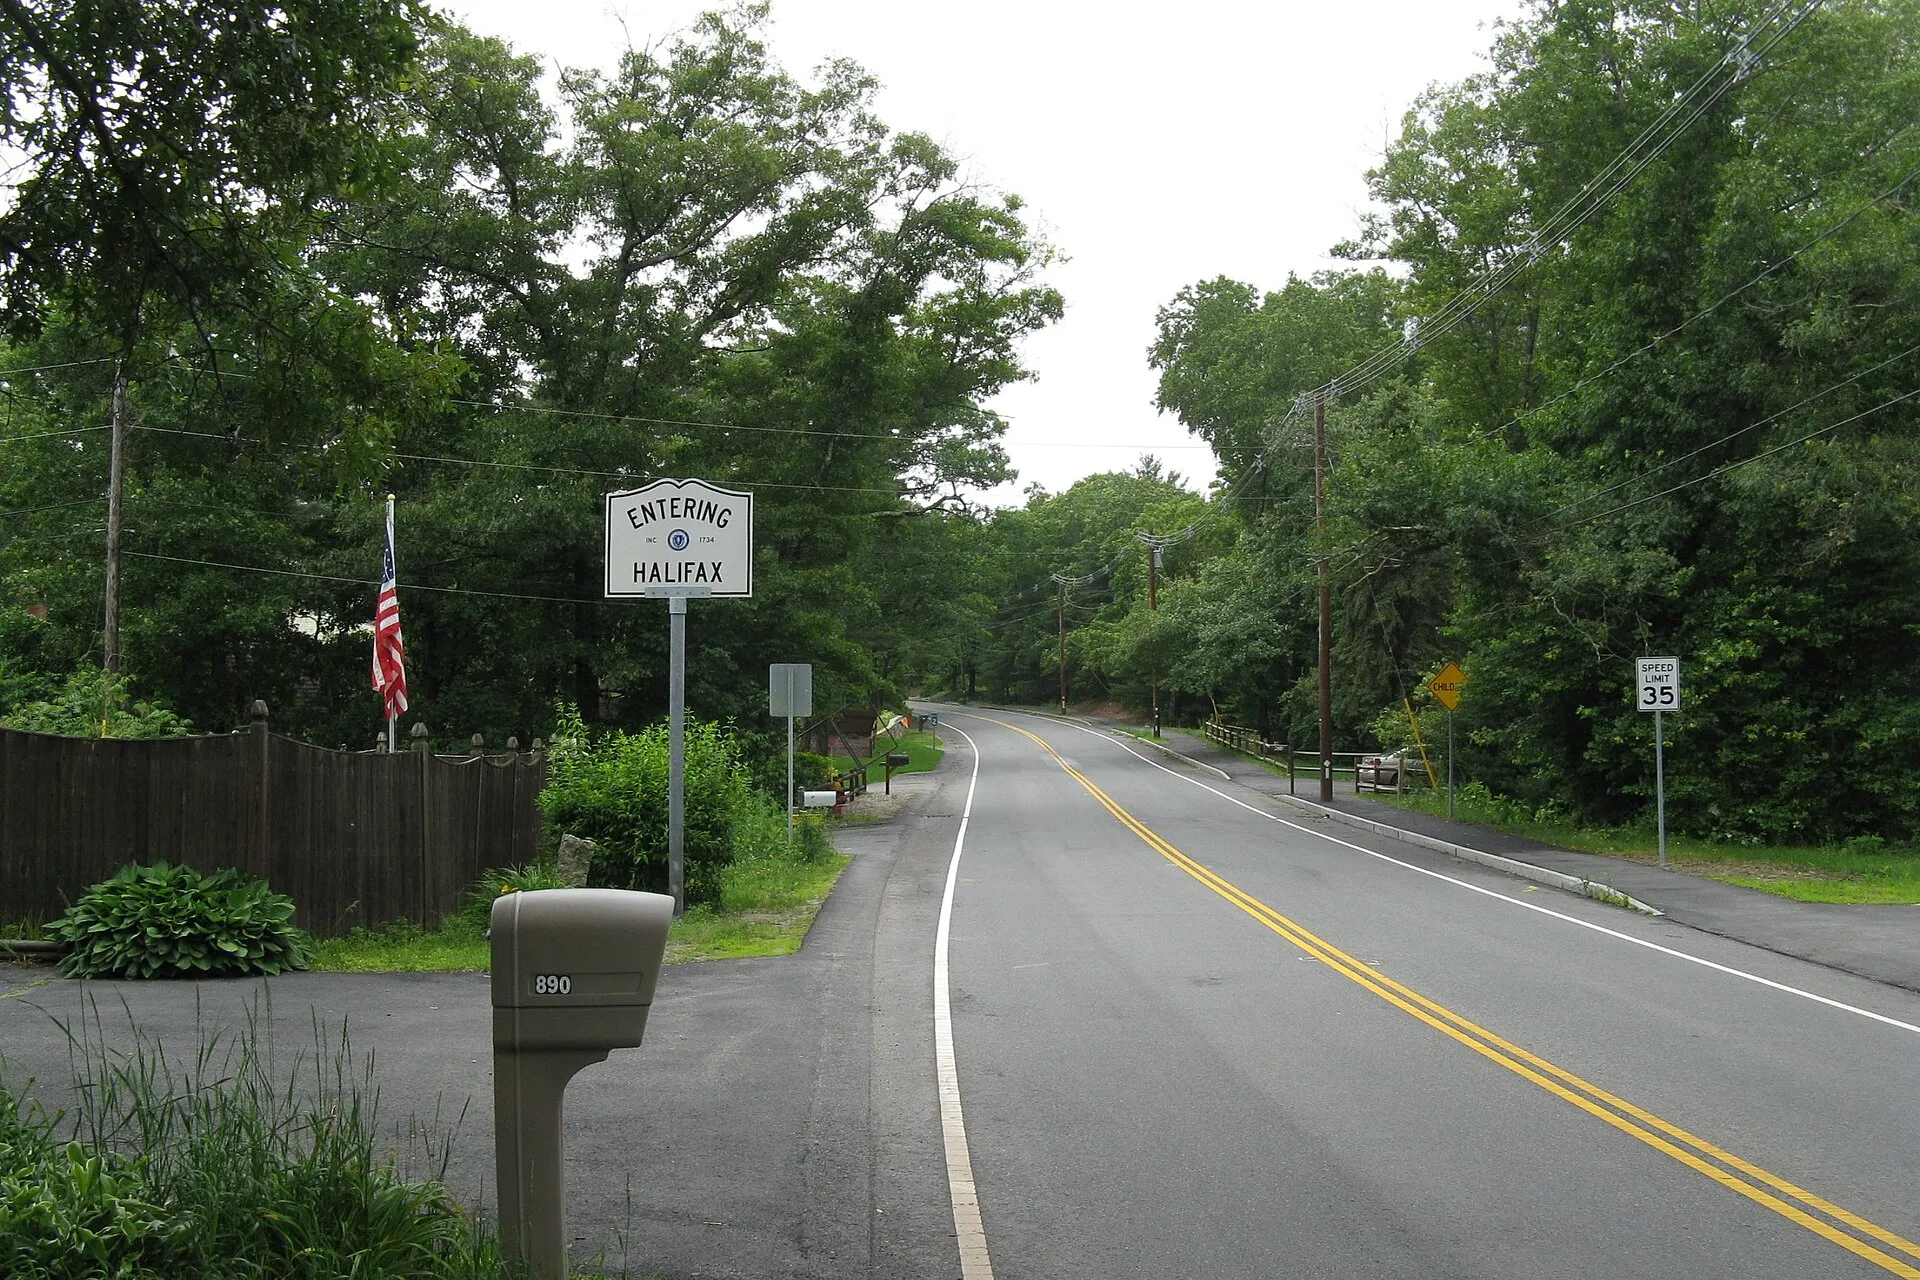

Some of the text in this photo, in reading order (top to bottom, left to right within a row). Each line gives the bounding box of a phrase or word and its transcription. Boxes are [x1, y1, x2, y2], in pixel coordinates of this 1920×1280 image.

[627, 498, 732, 529] ENTERING
[699, 536, 714, 544] 1734
[633, 562, 722, 583] HALIFAX
[1641, 663, 1674, 672] SPEED
[1645, 674, 1670, 683] LIMIT
[1642, 686, 1674, 705] 35
[535, 975, 571, 994] 890
